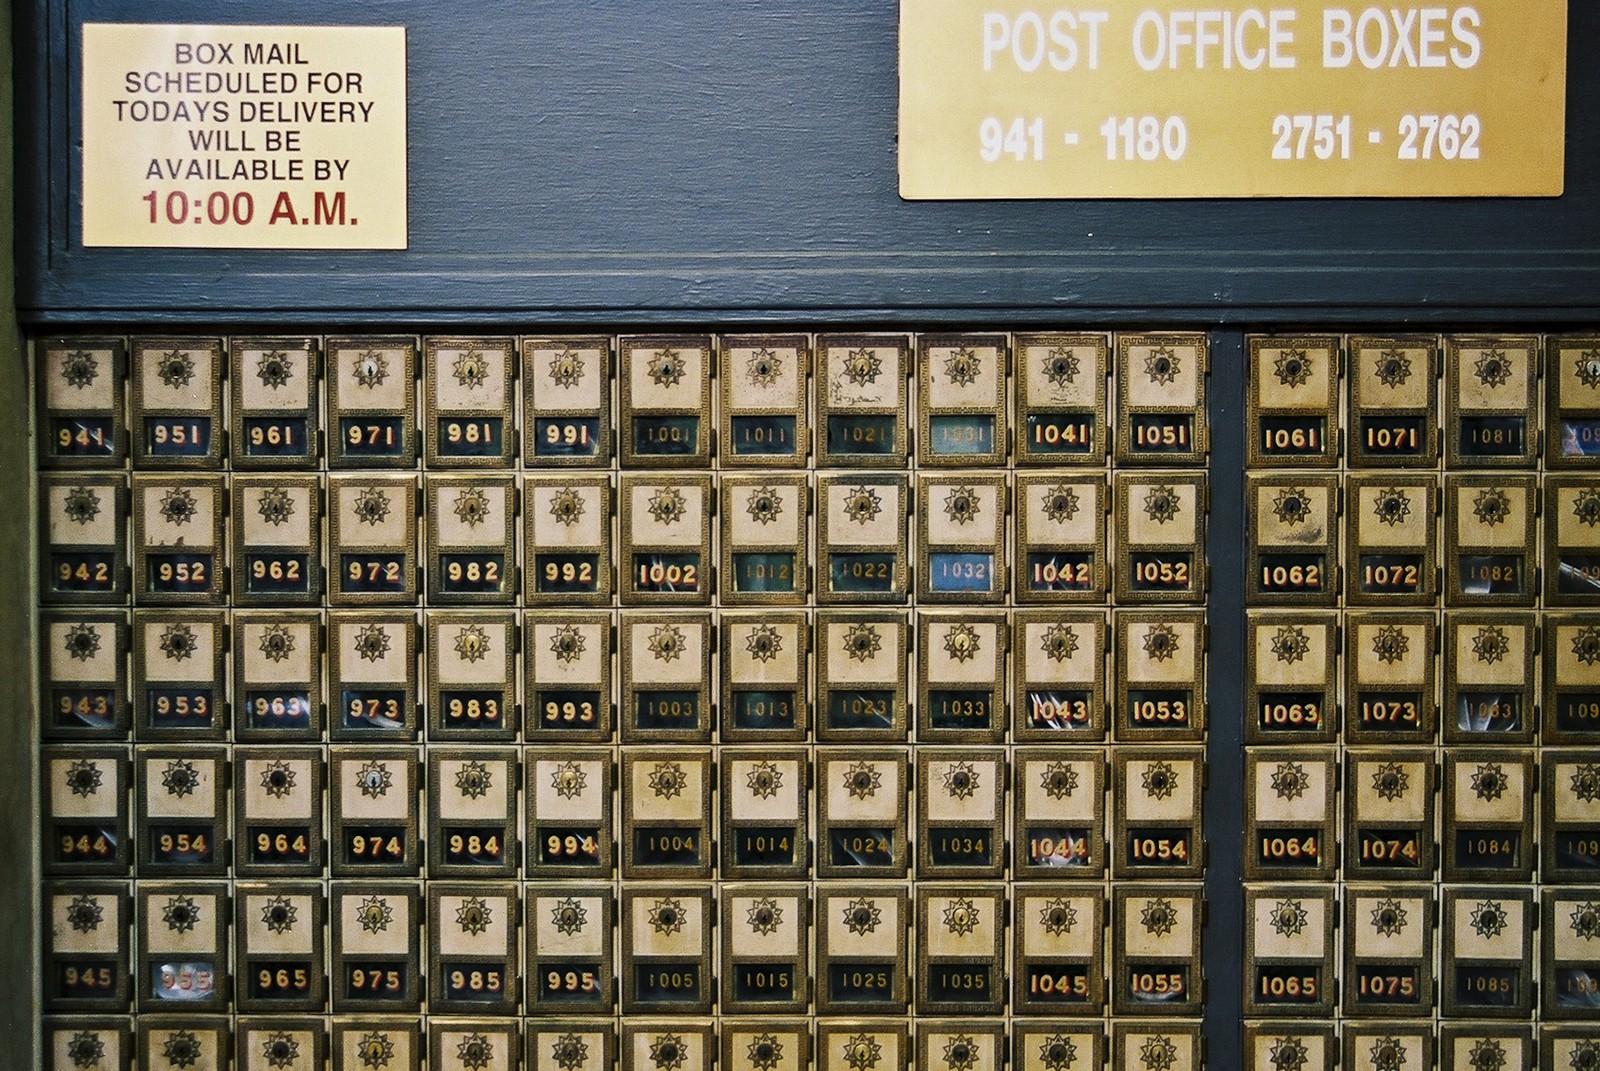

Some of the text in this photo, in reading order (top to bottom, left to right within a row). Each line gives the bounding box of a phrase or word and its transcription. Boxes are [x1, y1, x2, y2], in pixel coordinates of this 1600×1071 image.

[981, 7, 1482, 72] POST OFFICE BOXES
[175, 43, 308, 65] BOX MAIL
[125, 72, 363, 94] SCHEDULED FOR
[113, 101, 375, 123] TODAYS DELIVERY
[188, 130, 301, 152] WILL BE
[978, 117, 1046, 162] 941
[1099, 115, 1188, 161] 1180
[1271, 115, 1351, 160] 2751
[1398, 114, 1481, 160] 2762
[145, 159, 350, 181] AVAILABLE BY
[142, 190, 359, 225] 10:00 A.M.
[58, 427, 105, 446] 941
[155, 425, 200, 445] 951
[251, 426, 293, 446] 961
[349, 426, 394, 446] 971
[448, 423, 492, 443] 981
[546, 425, 589, 445] 991
[647, 428, 690, 442] 1001
[744, 427, 785, 442] 1011
[843, 427, 886, 442] 1021
[1035, 425, 1088, 445] 1041
[1137, 424, 1187, 445] 1051
[1264, 427, 1316, 448] 1061
[1367, 427, 1417, 448] 1071
[1472, 428, 1512, 443] 1081
[59, 562, 109, 581] 942
[159, 562, 205, 581] 952
[253, 560, 300, 581] 962
[349, 562, 400, 581] 972
[448, 562, 498, 581] 982
[545, 562, 593, 583] 992
[640, 563, 697, 585] 1002
[745, 562, 788, 578] 1012
[841, 562, 887, 578] 1022
[942, 562, 985, 578] 1032
[1035, 562, 1090, 583] 1042
[1136, 562, 1189, 583] 1052
[1263, 564, 1319, 585] 1062
[1365, 564, 1419, 586] 1072
[1469, 564, 1513, 580] 1082
[1569, 565, 1600, 580] 109
[60, 697, 108, 715] 943
[157, 697, 208, 715] 953
[256, 697, 302, 716] 963
[351, 698, 400, 719] 973
[449, 698, 498, 719] 983
[545, 701, 593, 722] 993
[649, 701, 692, 716] 1003
[745, 701, 788, 717] 1013
[841, 699, 887, 715] 1023
[941, 701, 985, 716] 1033
[1033, 699, 1088, 722] 1043
[1133, 700, 1187, 722] 1053
[1264, 703, 1318, 725] 1063
[1363, 701, 1416, 722] 1073
[1568, 703, 1600, 718] 109
[62, 835, 109, 854] 944
[160, 834, 207, 853] 954
[257, 834, 308, 854] 964
[352, 836, 402, 856] 974
[450, 834, 500, 855] 984
[548, 835, 597, 855] 994
[650, 836, 694, 850] 1004
[746, 836, 789, 851] 1014
[842, 837, 888, 853] 1024
[941, 837, 984, 853] 1034
[1030, 837, 1088, 858] 1044
[1133, 839, 1187, 859] 1054
[1263, 836, 1317, 857] 1064
[1363, 839, 1418, 860] 1074
[1468, 839, 1511, 854] 1084
[1568, 840, 1600, 855] 109
[65, 968, 111, 986] 945
[259, 970, 308, 989] 965
[352, 970, 400, 990] 975
[451, 971, 501, 990] 985
[548, 971, 596, 990] 995
[650, 973, 693, 988] 1005
[746, 972, 788, 988] 1015
[841, 972, 887, 988] 1025
[941, 973, 985, 989] 1035
[1031, 974, 1088, 995] 1045
[1132, 973, 1184, 994] 1055
[1262, 976, 1316, 996] 1065
[1360, 975, 1414, 996] 1075
[1466, 978, 1509, 992] 1085
